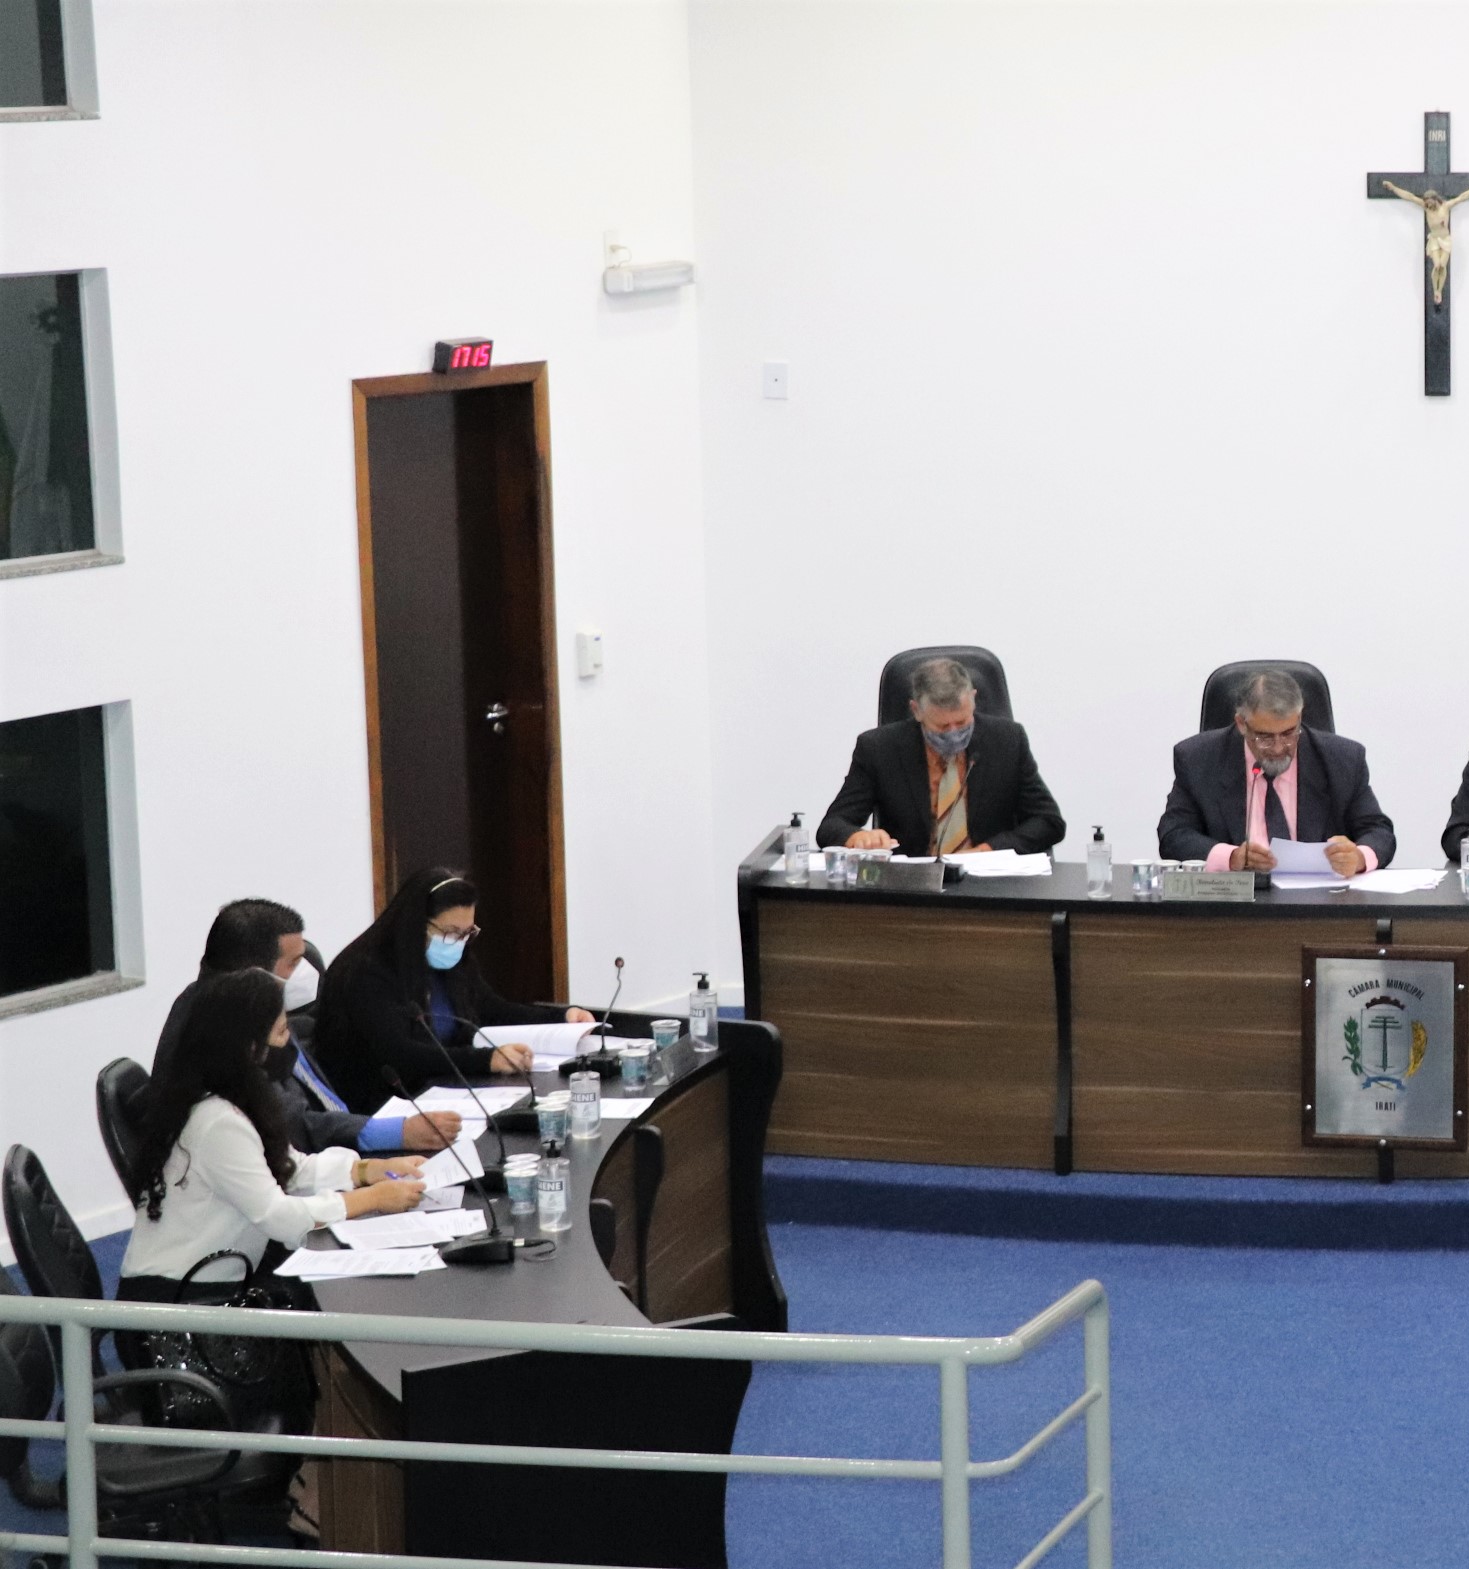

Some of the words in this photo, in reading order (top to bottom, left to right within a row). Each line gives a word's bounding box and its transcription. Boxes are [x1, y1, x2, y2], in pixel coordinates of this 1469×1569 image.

[1428, 130, 1446, 141] INRI
[451, 343, 491, 368] 1715
[1386, 979, 1425, 1000] MUNICIPAL
[1375, 1101, 1396, 1111] IRATI
